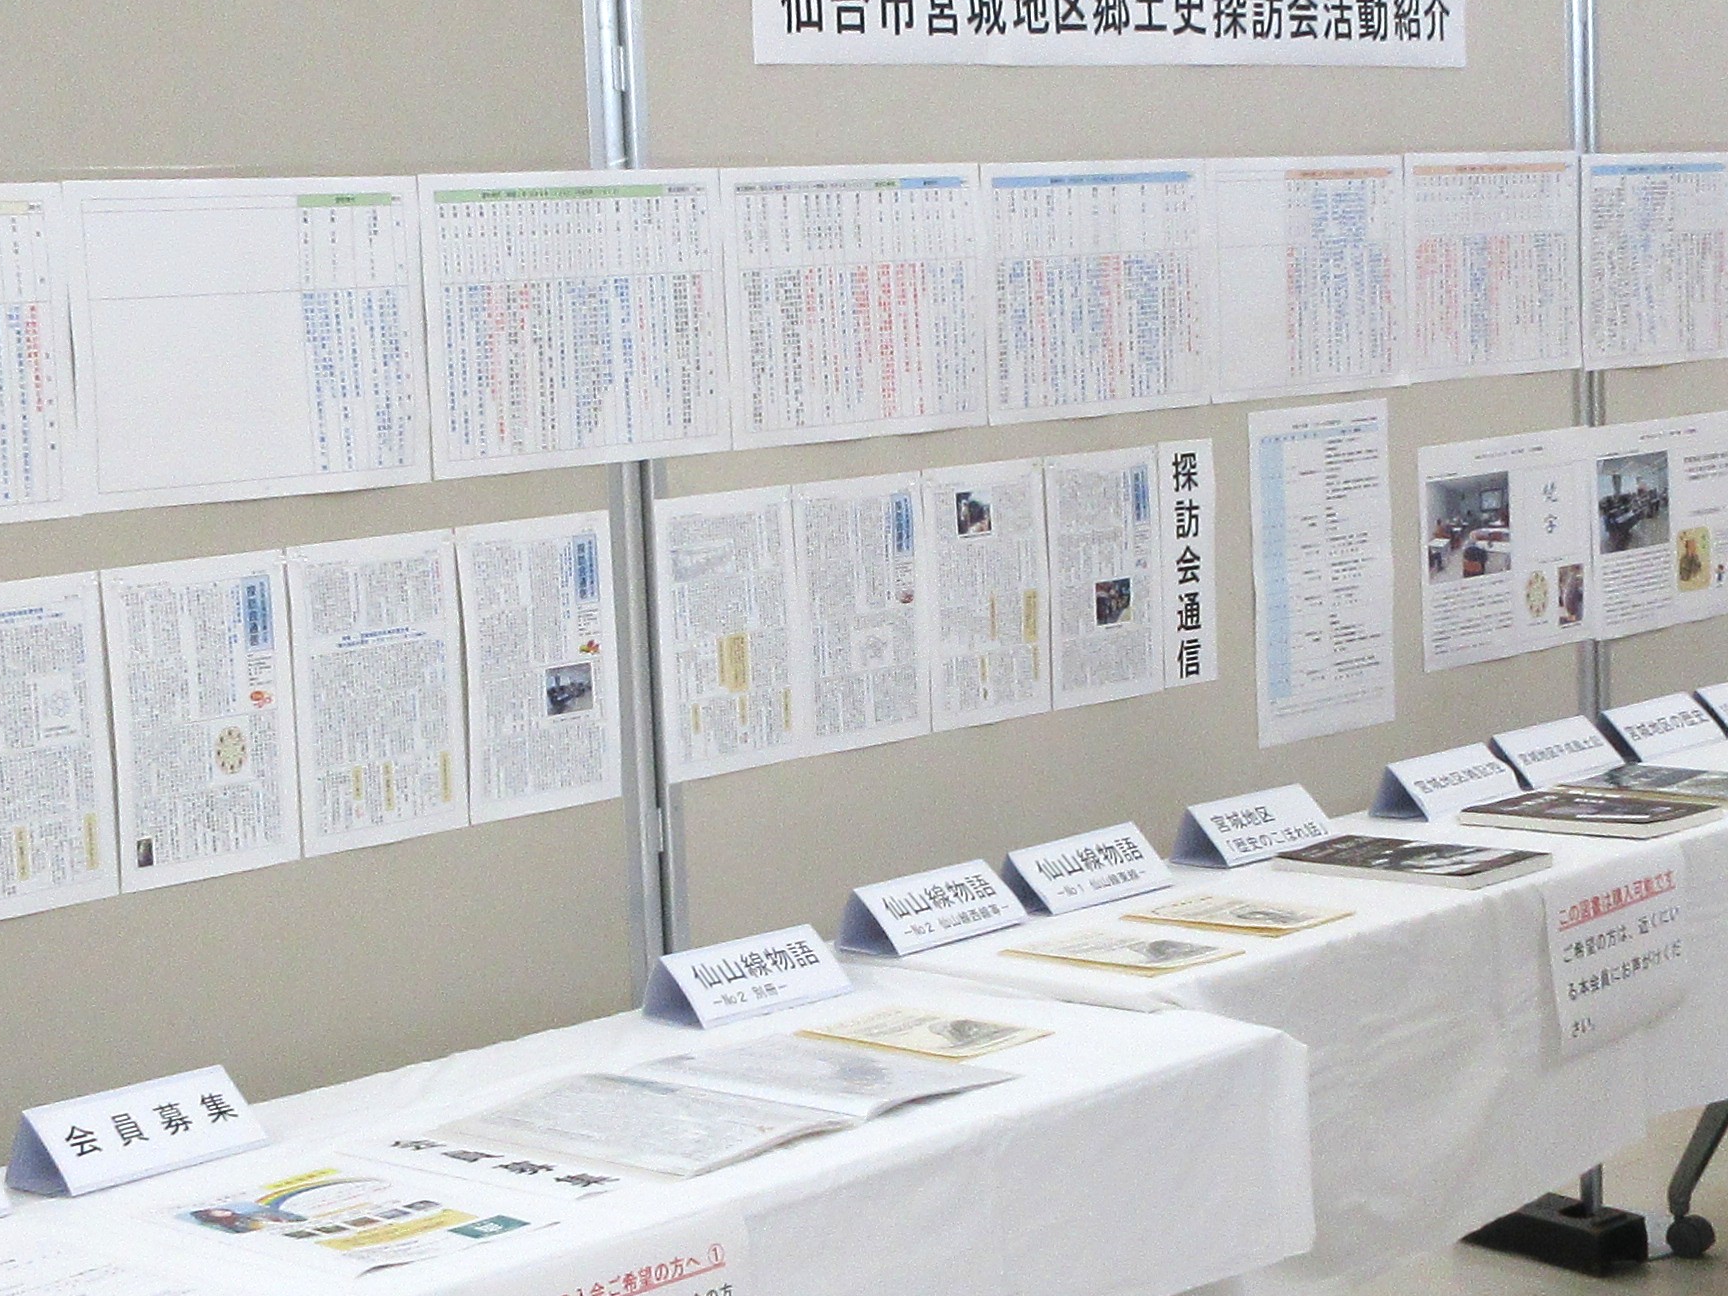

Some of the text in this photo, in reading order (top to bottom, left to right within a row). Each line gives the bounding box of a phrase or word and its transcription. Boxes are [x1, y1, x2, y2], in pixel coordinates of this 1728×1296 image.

[1172, 452, 1202, 680] 探訪会通信
[1210, 806, 1276, 834] 宮城地区
[1035, 836, 1144, 882] 仙山線物語
[882, 874, 998, 921] 仙山線物語
[690, 940, 821, 991] 仙山線物語
[64, 1092, 239, 1158] 会員募集
